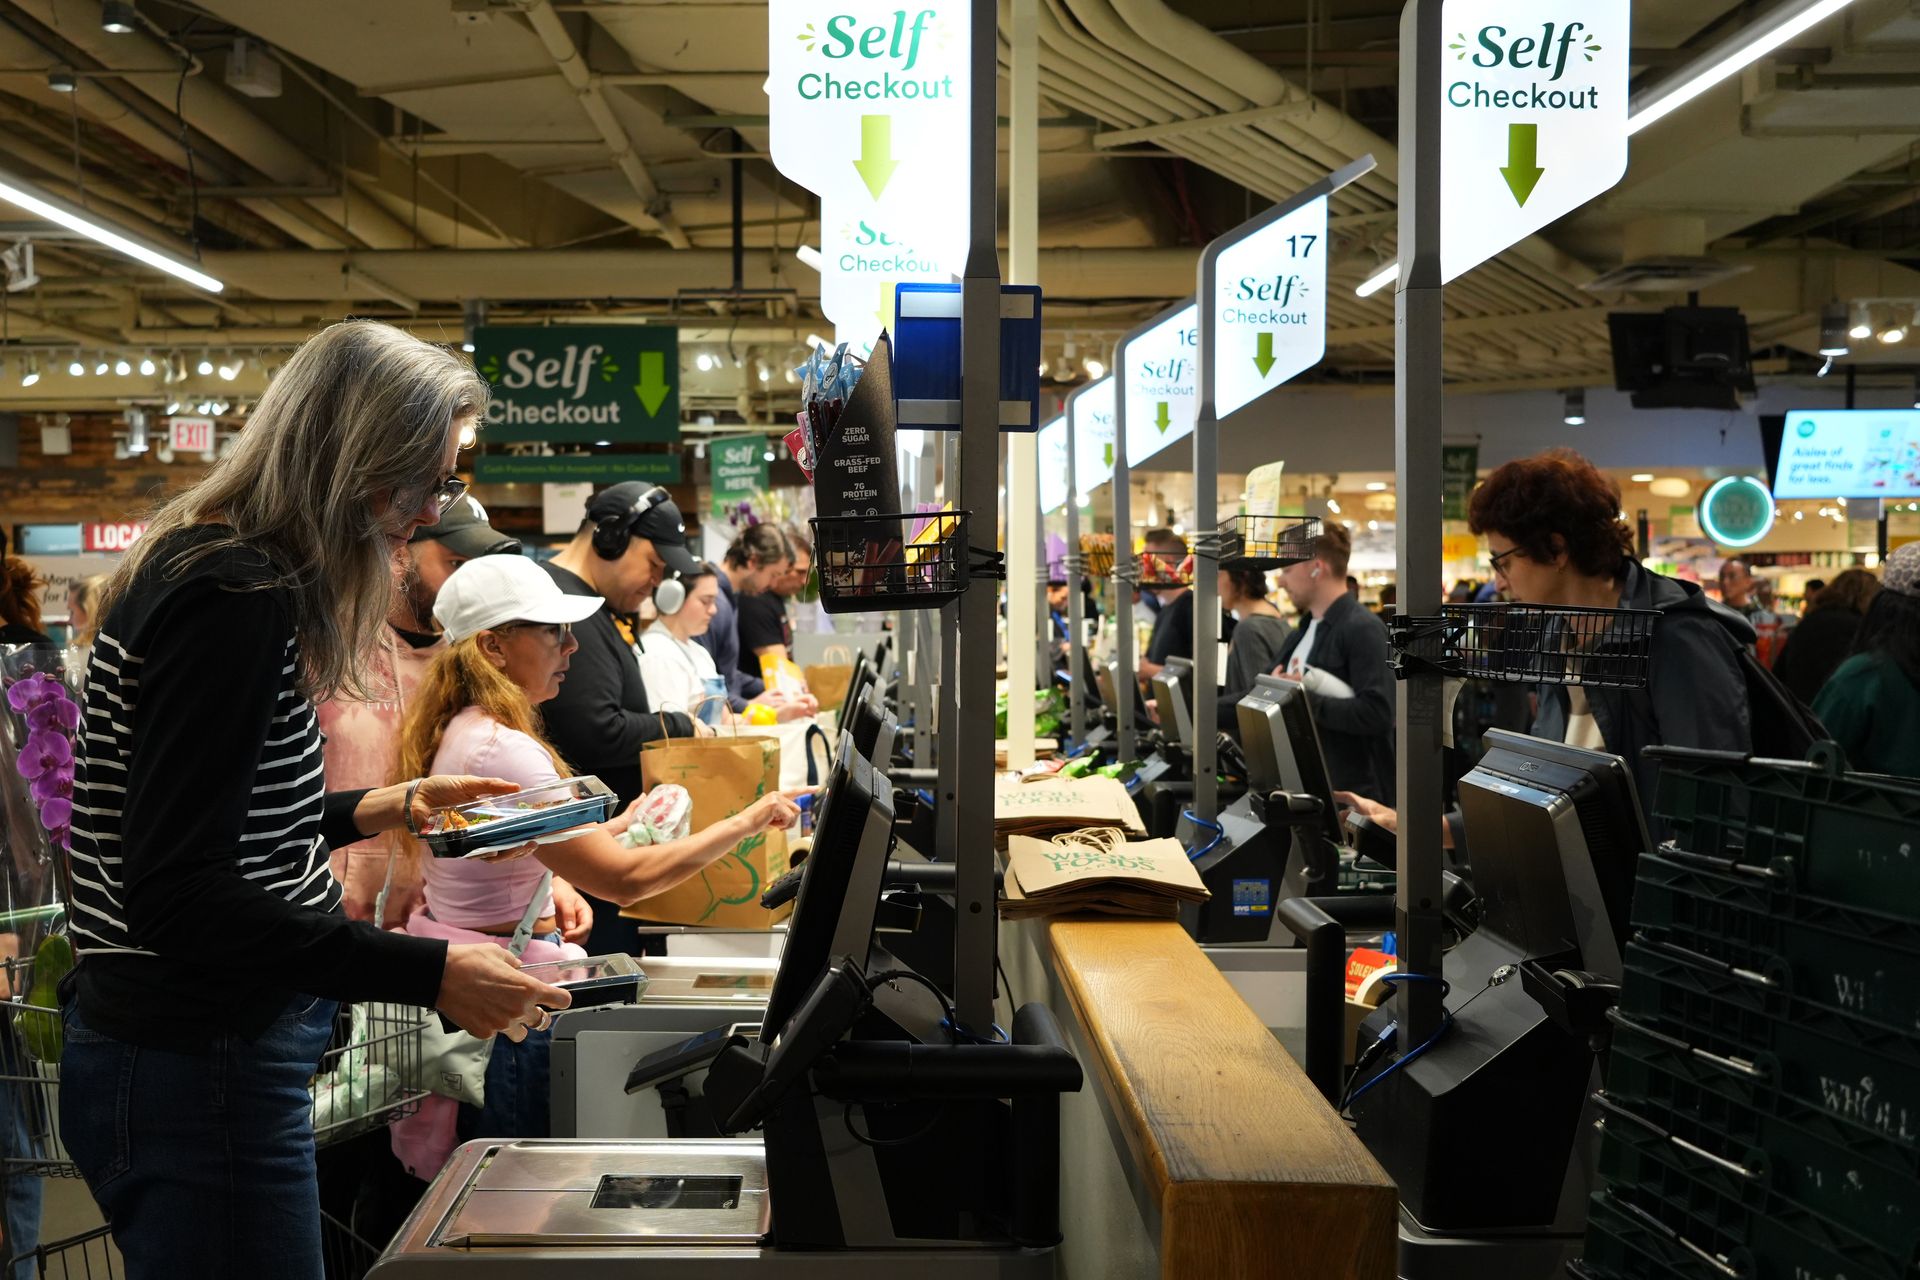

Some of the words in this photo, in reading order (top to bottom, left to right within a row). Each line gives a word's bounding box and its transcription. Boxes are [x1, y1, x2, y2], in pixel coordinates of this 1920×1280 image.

[822, 10, 936, 71] Self
[1472, 22, 1585, 82] Self
[797, 72, 953, 100] Checkout
[1448, 81, 1599, 109] Checkout
[1286, 235, 1317, 258] 17
[1236, 275, 1300, 309] Self
[1222, 308, 1307, 325] Checkout
[1177, 329, 1198, 346] 16
[502, 345, 603, 400] Self
[1140, 358, 1188, 383] Self
[486, 399, 621, 424] Checkout
[175, 422, 209, 449] EXIT
[841, 433, 870, 443] SUGAR
[844, 426, 866, 435] ZERO
[834, 456, 881, 467] GRASS-FED
[848, 465, 869, 474] BEEF
[842, 489, 878, 499] PROTEIN
[854, 482, 865, 490] 7G
[93, 524, 150, 549] LOCA
[1053, 856, 1156, 872] FOODS
